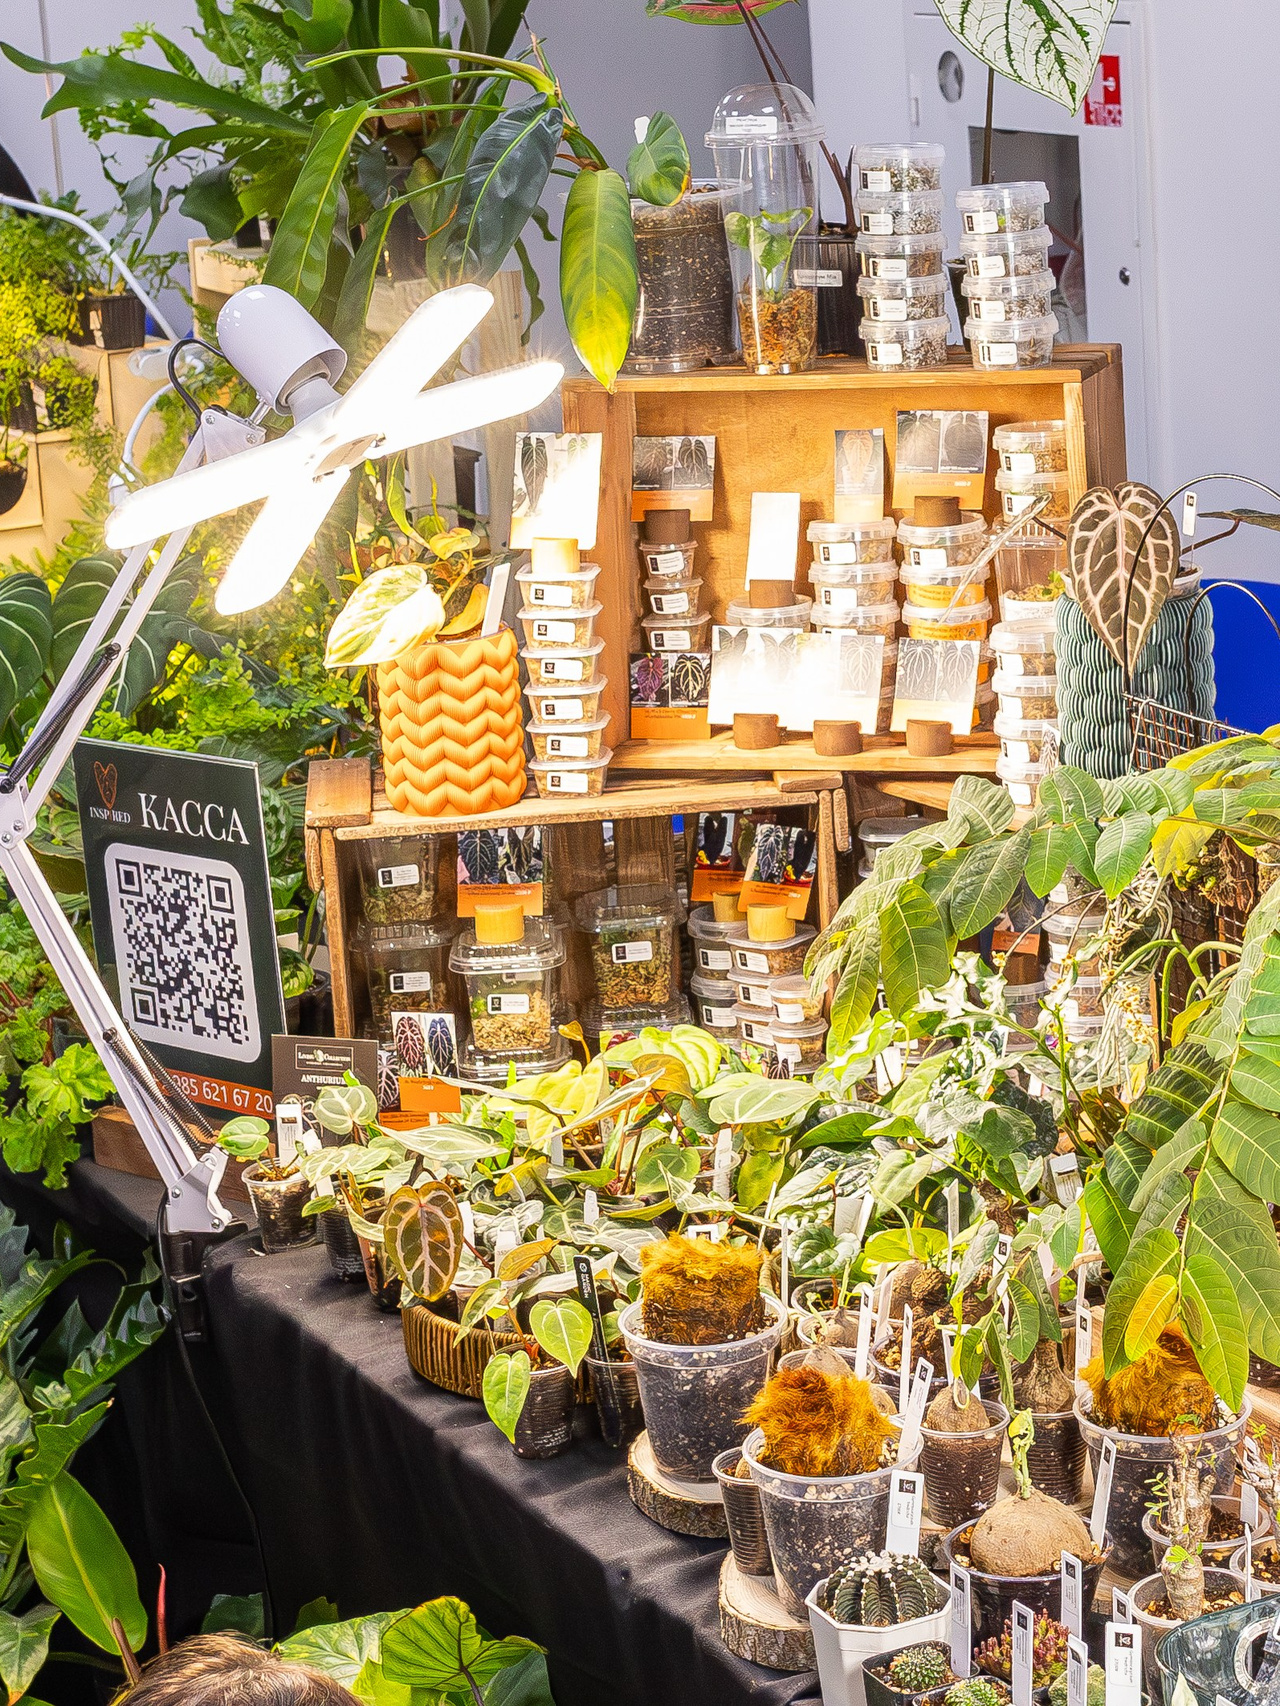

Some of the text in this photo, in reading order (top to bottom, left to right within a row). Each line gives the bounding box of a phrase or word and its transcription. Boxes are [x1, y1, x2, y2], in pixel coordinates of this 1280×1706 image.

[137, 792, 251, 845] КАССА
[202, 1081, 228, 1104] 621
[233, 1088, 250, 1108] 67
[254, 1093, 273, 1114] 20
